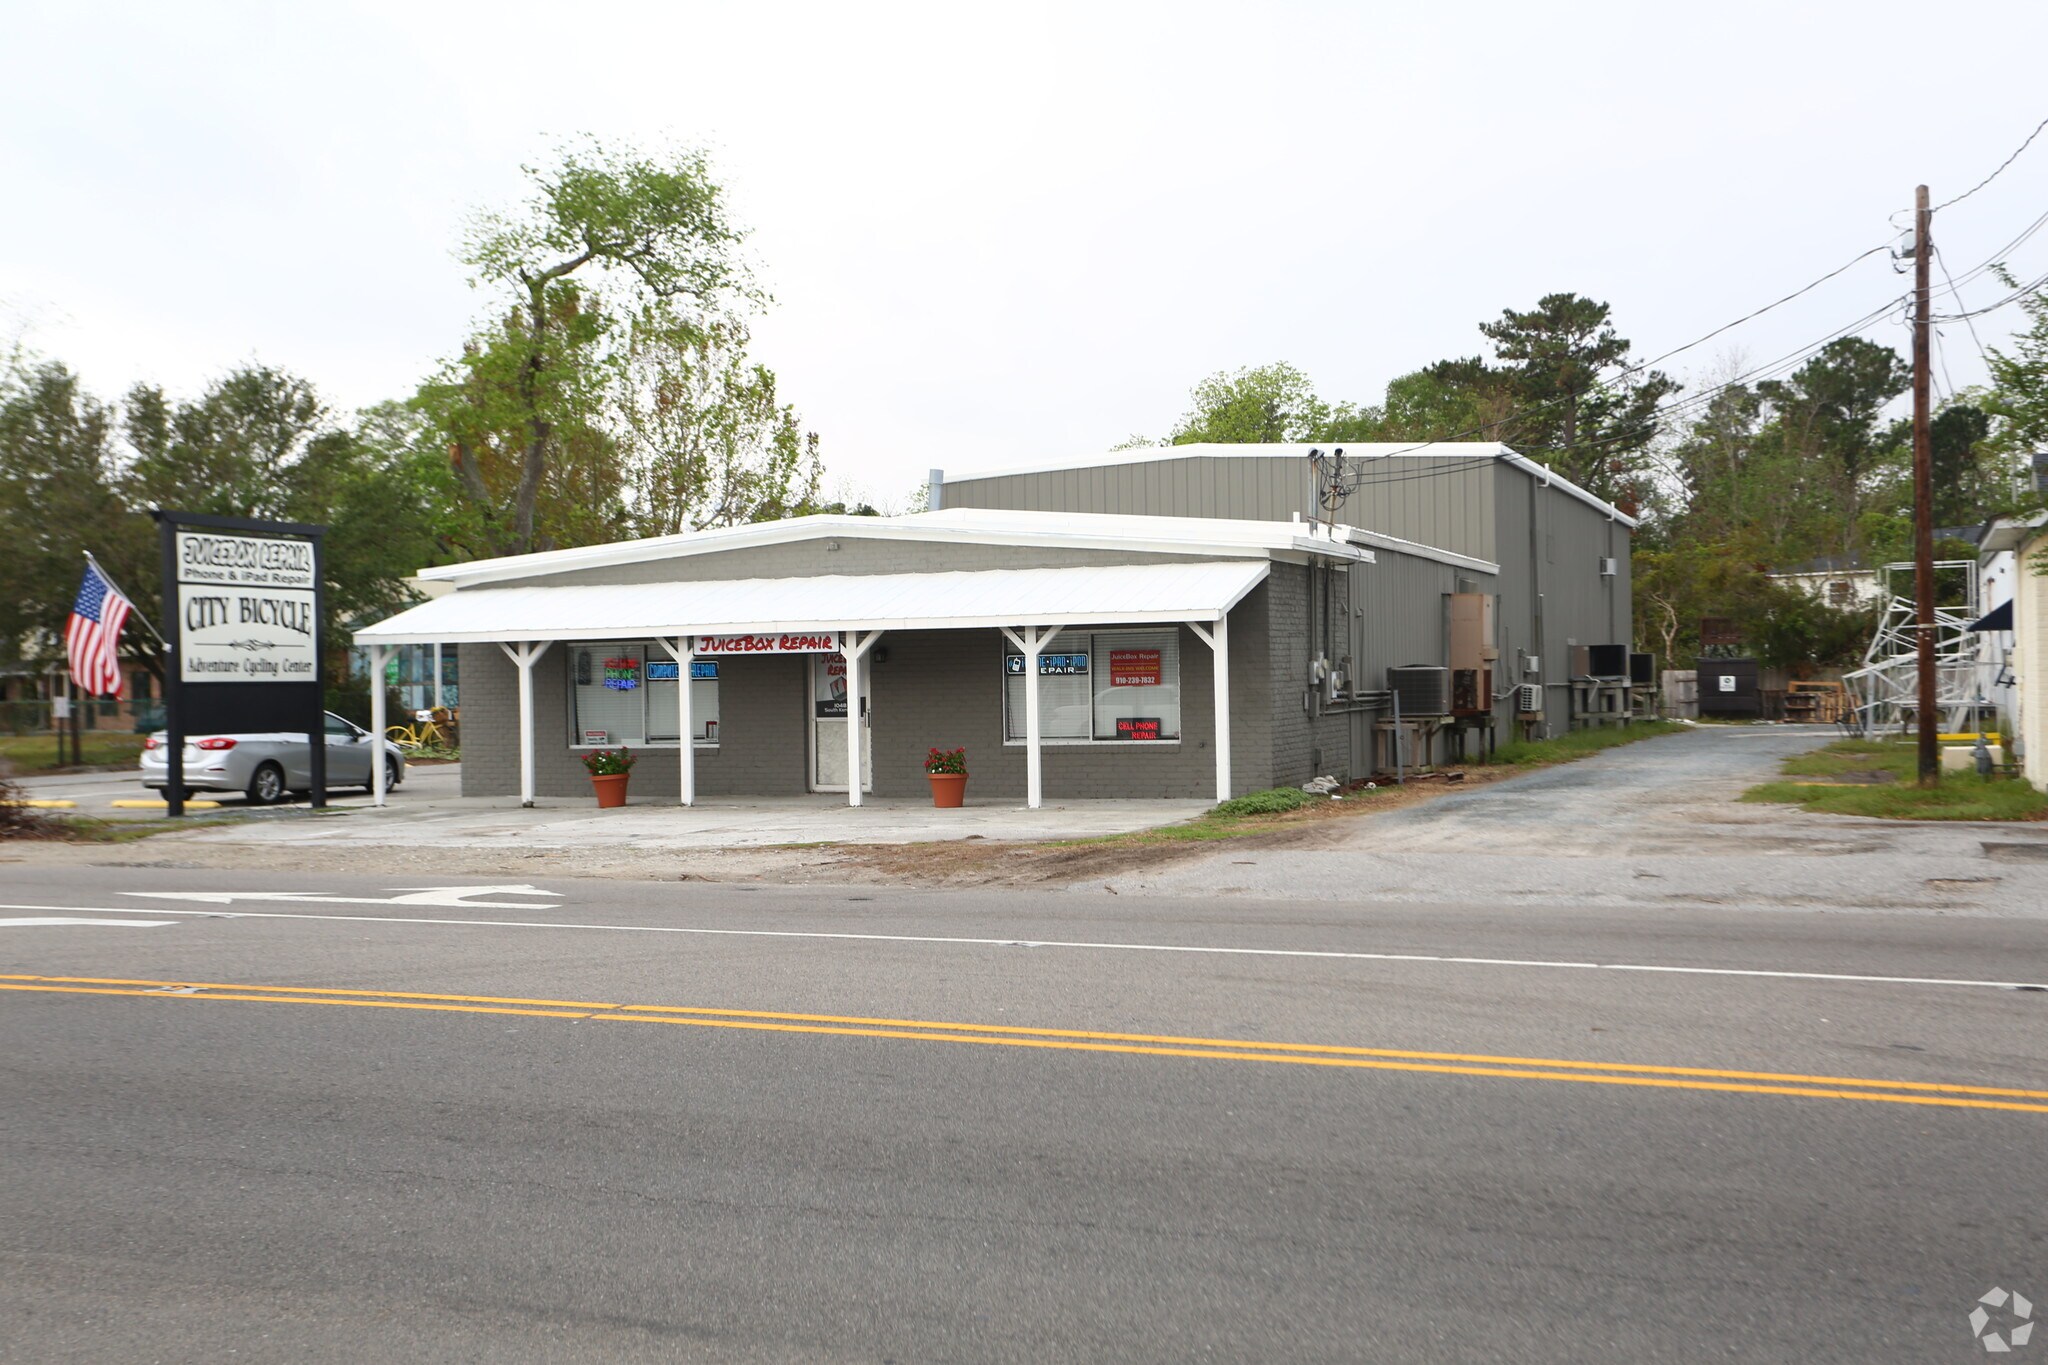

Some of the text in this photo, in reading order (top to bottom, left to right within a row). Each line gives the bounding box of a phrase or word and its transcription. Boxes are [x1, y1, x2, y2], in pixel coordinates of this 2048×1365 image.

[184, 568, 310, 585] Phone & iPad Repair
[187, 596, 312, 636] CITY BICYCLE
[779, 634, 832, 650] REPAIR
[187, 657, 312, 677] Adventure Cycling Center
[649, 664, 679, 678] COMPUTE
[605, 679, 637, 690] REPAIR
[1118, 721, 1158, 731] CELL PHONE
[1131, 731, 1157, 740] REPAIR
